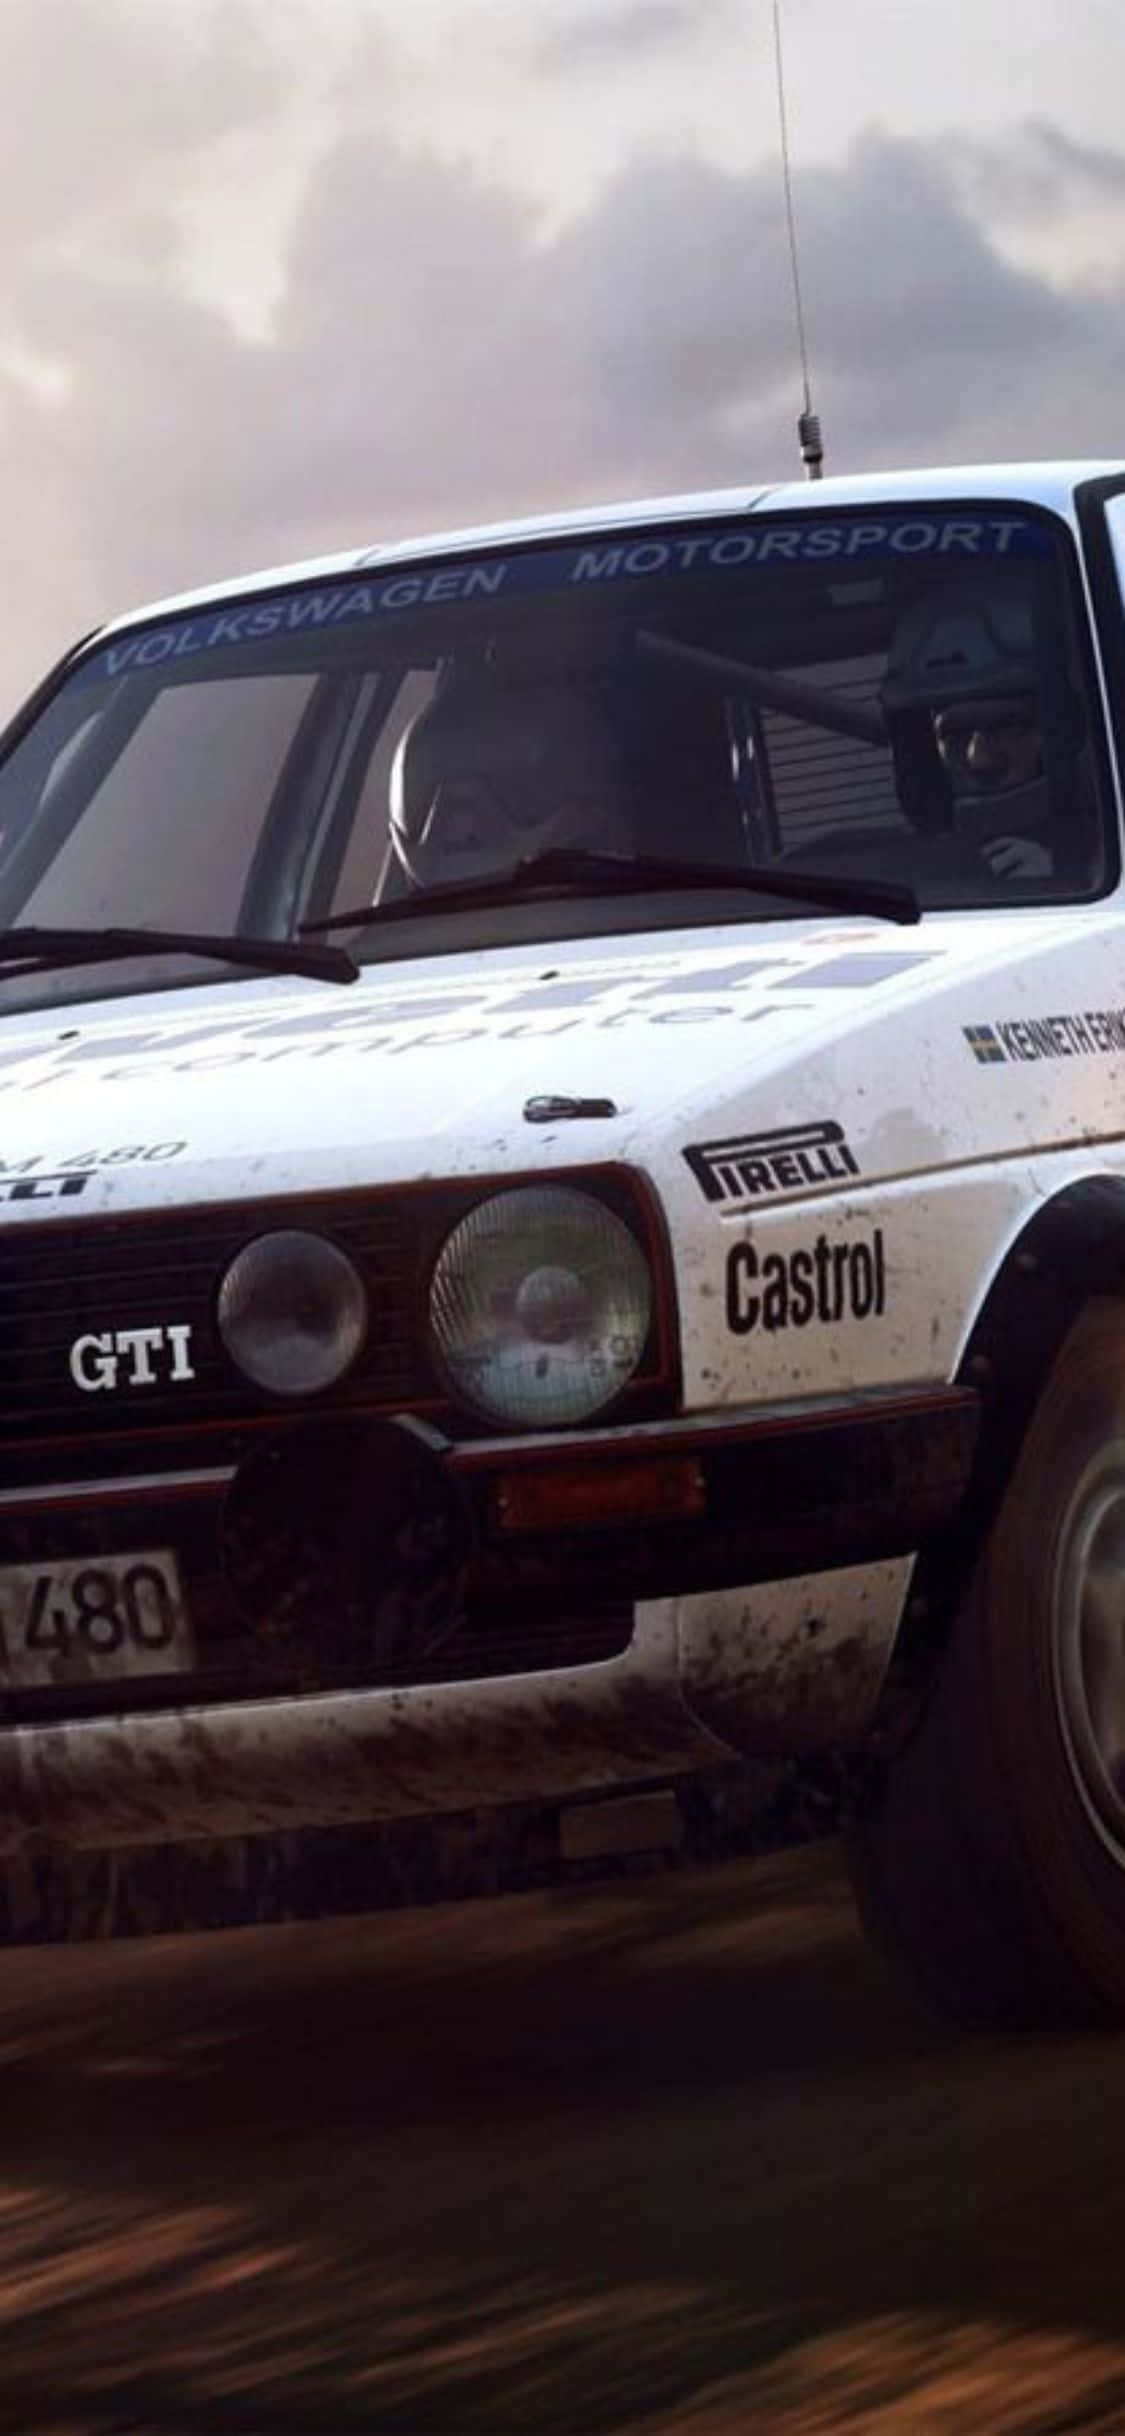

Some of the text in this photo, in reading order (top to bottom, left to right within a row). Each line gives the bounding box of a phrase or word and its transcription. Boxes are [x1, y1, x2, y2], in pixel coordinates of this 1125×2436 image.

[102, 520, 1027, 676] VOLKSWAGEN MOTORSPORT
[100, 1003, 816, 1081] computer
[995, 1015, 1097, 1063] KENNETH
[57, 1140, 188, 1168] 480
[682, 1119, 860, 1203] PIRELLI
[725, 1228, 885, 1335] Castrol
[69, 1325, 195, 1391] GTI
[25, 1564, 176, 1659] 480
